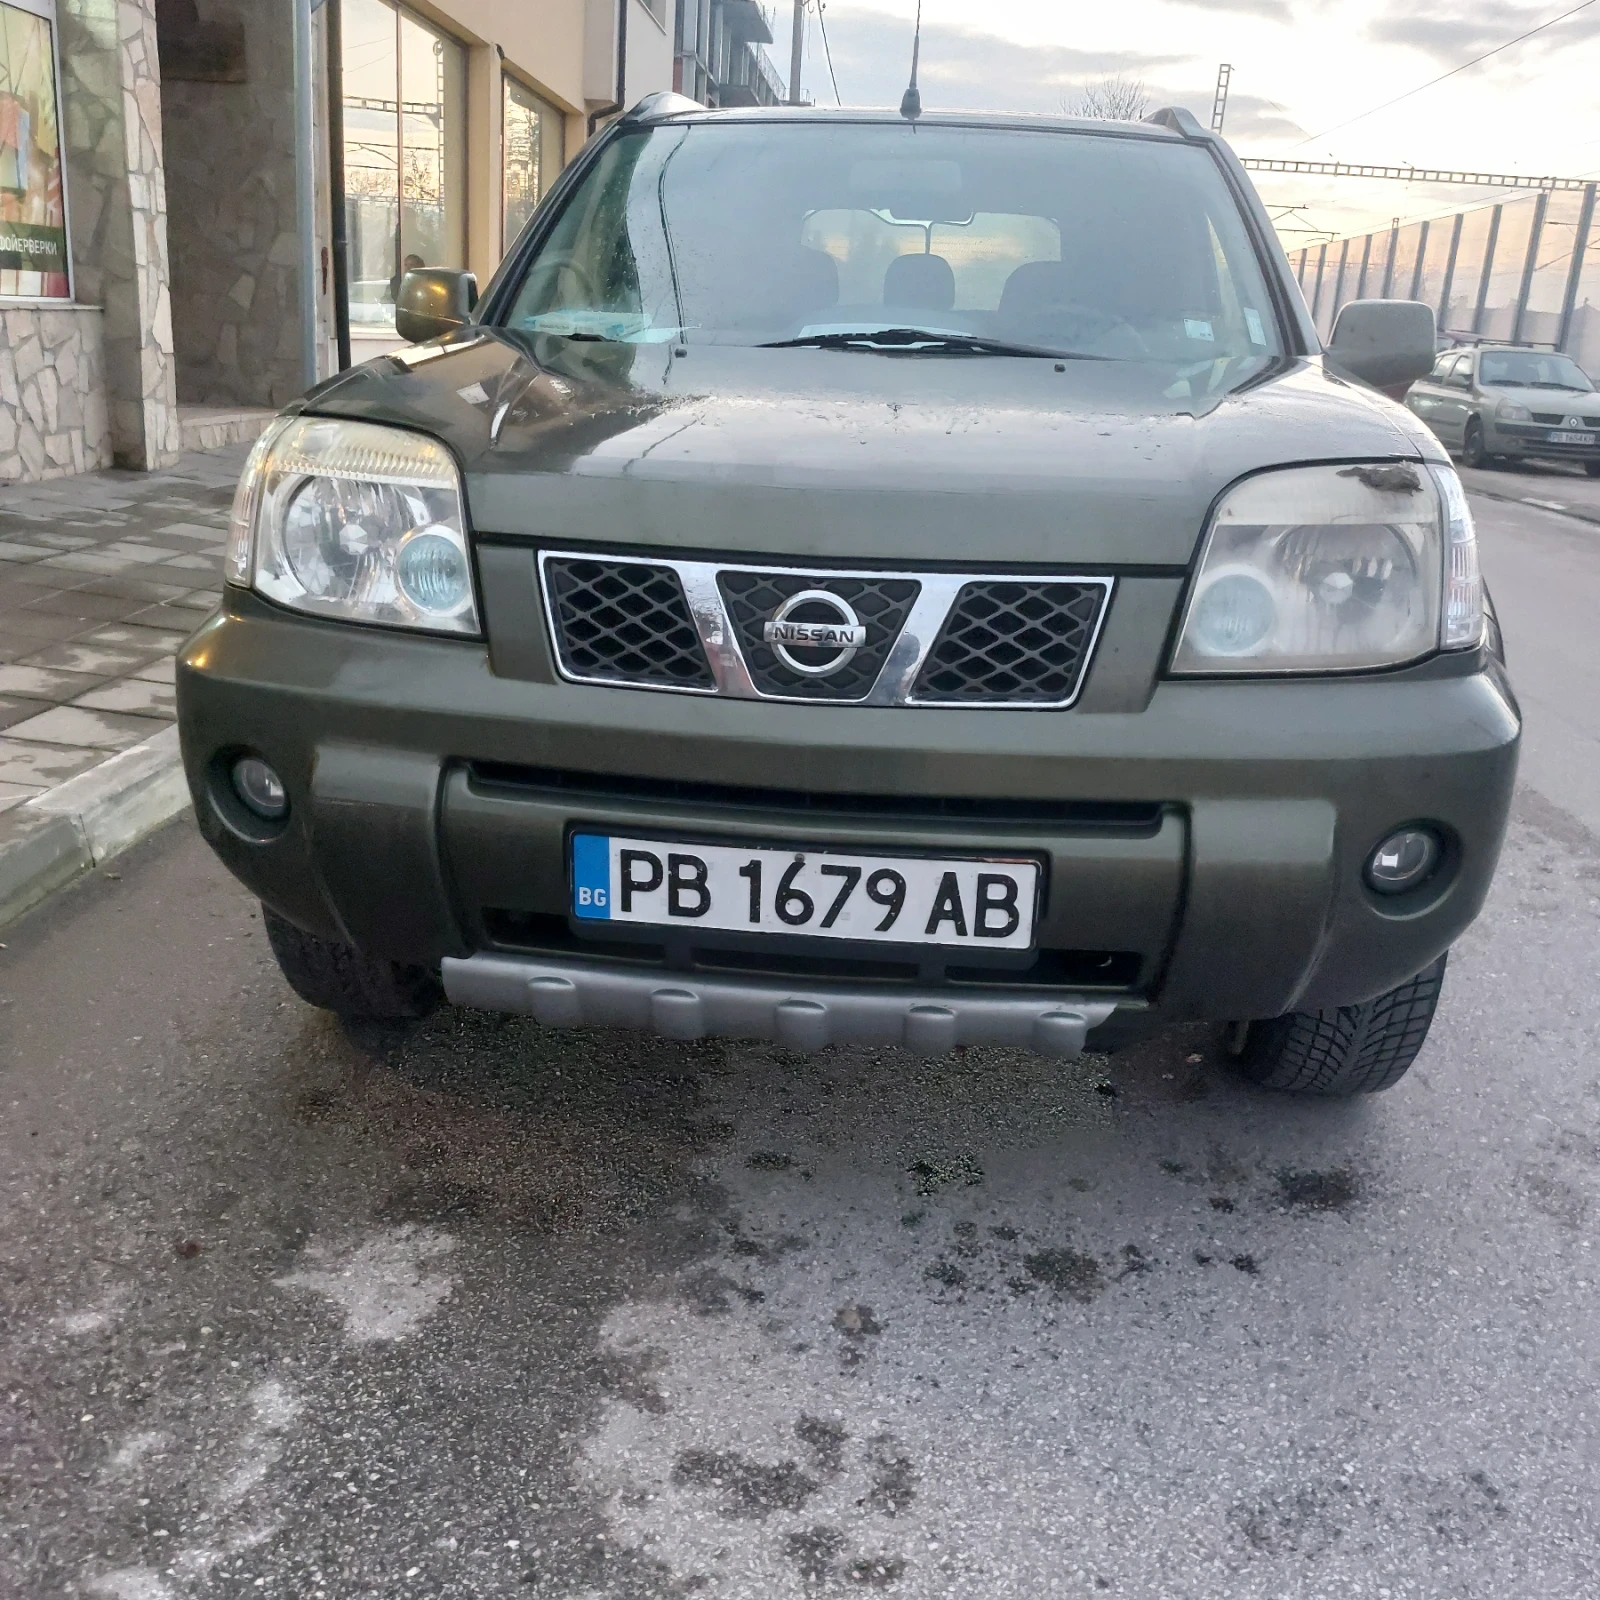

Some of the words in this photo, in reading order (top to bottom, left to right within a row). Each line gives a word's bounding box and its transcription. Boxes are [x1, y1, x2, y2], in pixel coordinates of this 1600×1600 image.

[774, 626, 854, 643] NISSAN
[579, 887, 606, 906] BG
[620, 849, 711, 917] PB
[738, 859, 907, 932] 1679
[924, 871, 1019, 938] AB
